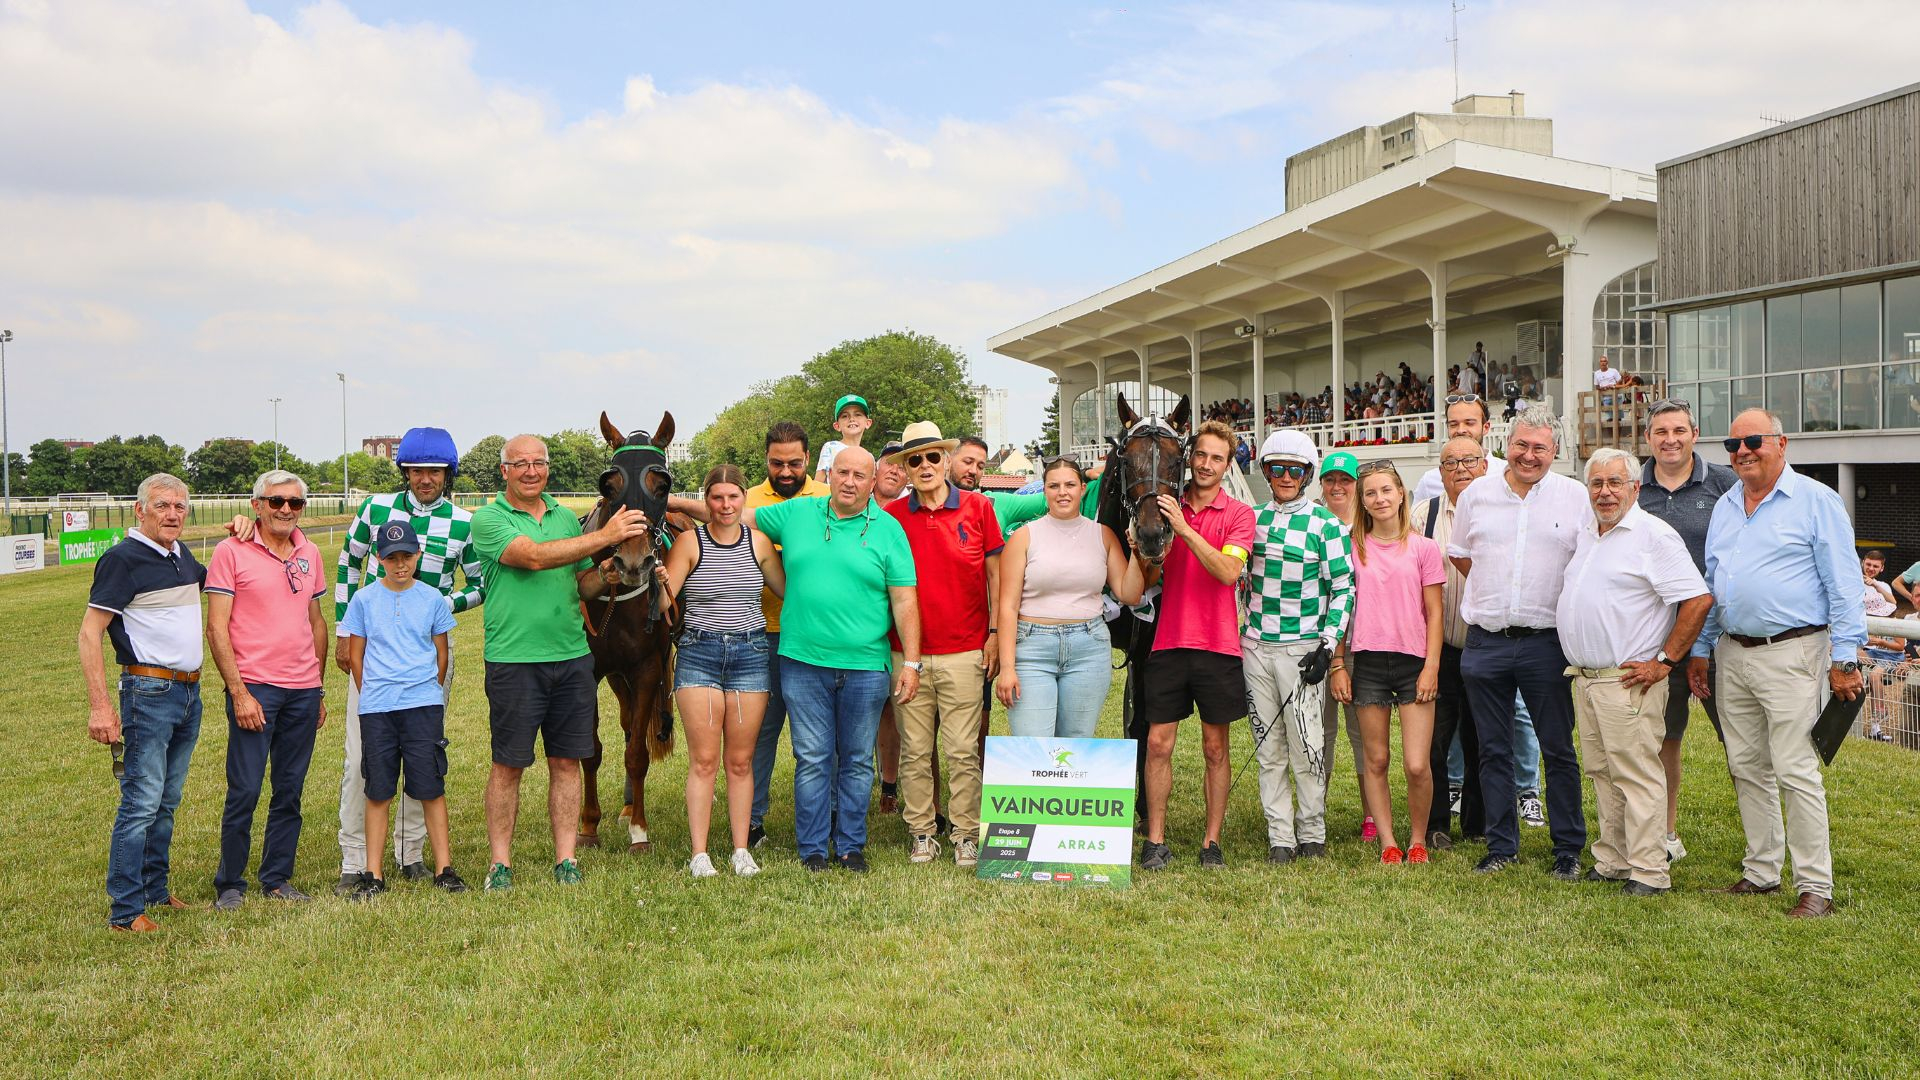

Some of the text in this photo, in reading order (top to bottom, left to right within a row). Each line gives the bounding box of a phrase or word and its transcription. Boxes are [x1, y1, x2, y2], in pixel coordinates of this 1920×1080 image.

[64, 537, 96, 561] TROPHÉE
[1246, 690, 1266, 741] VICTORY
[1032, 769, 1069, 778] TROPHÉE
[991, 797, 1123, 817] VAINQUEUR
[1058, 840, 1106, 851] ARRAS
